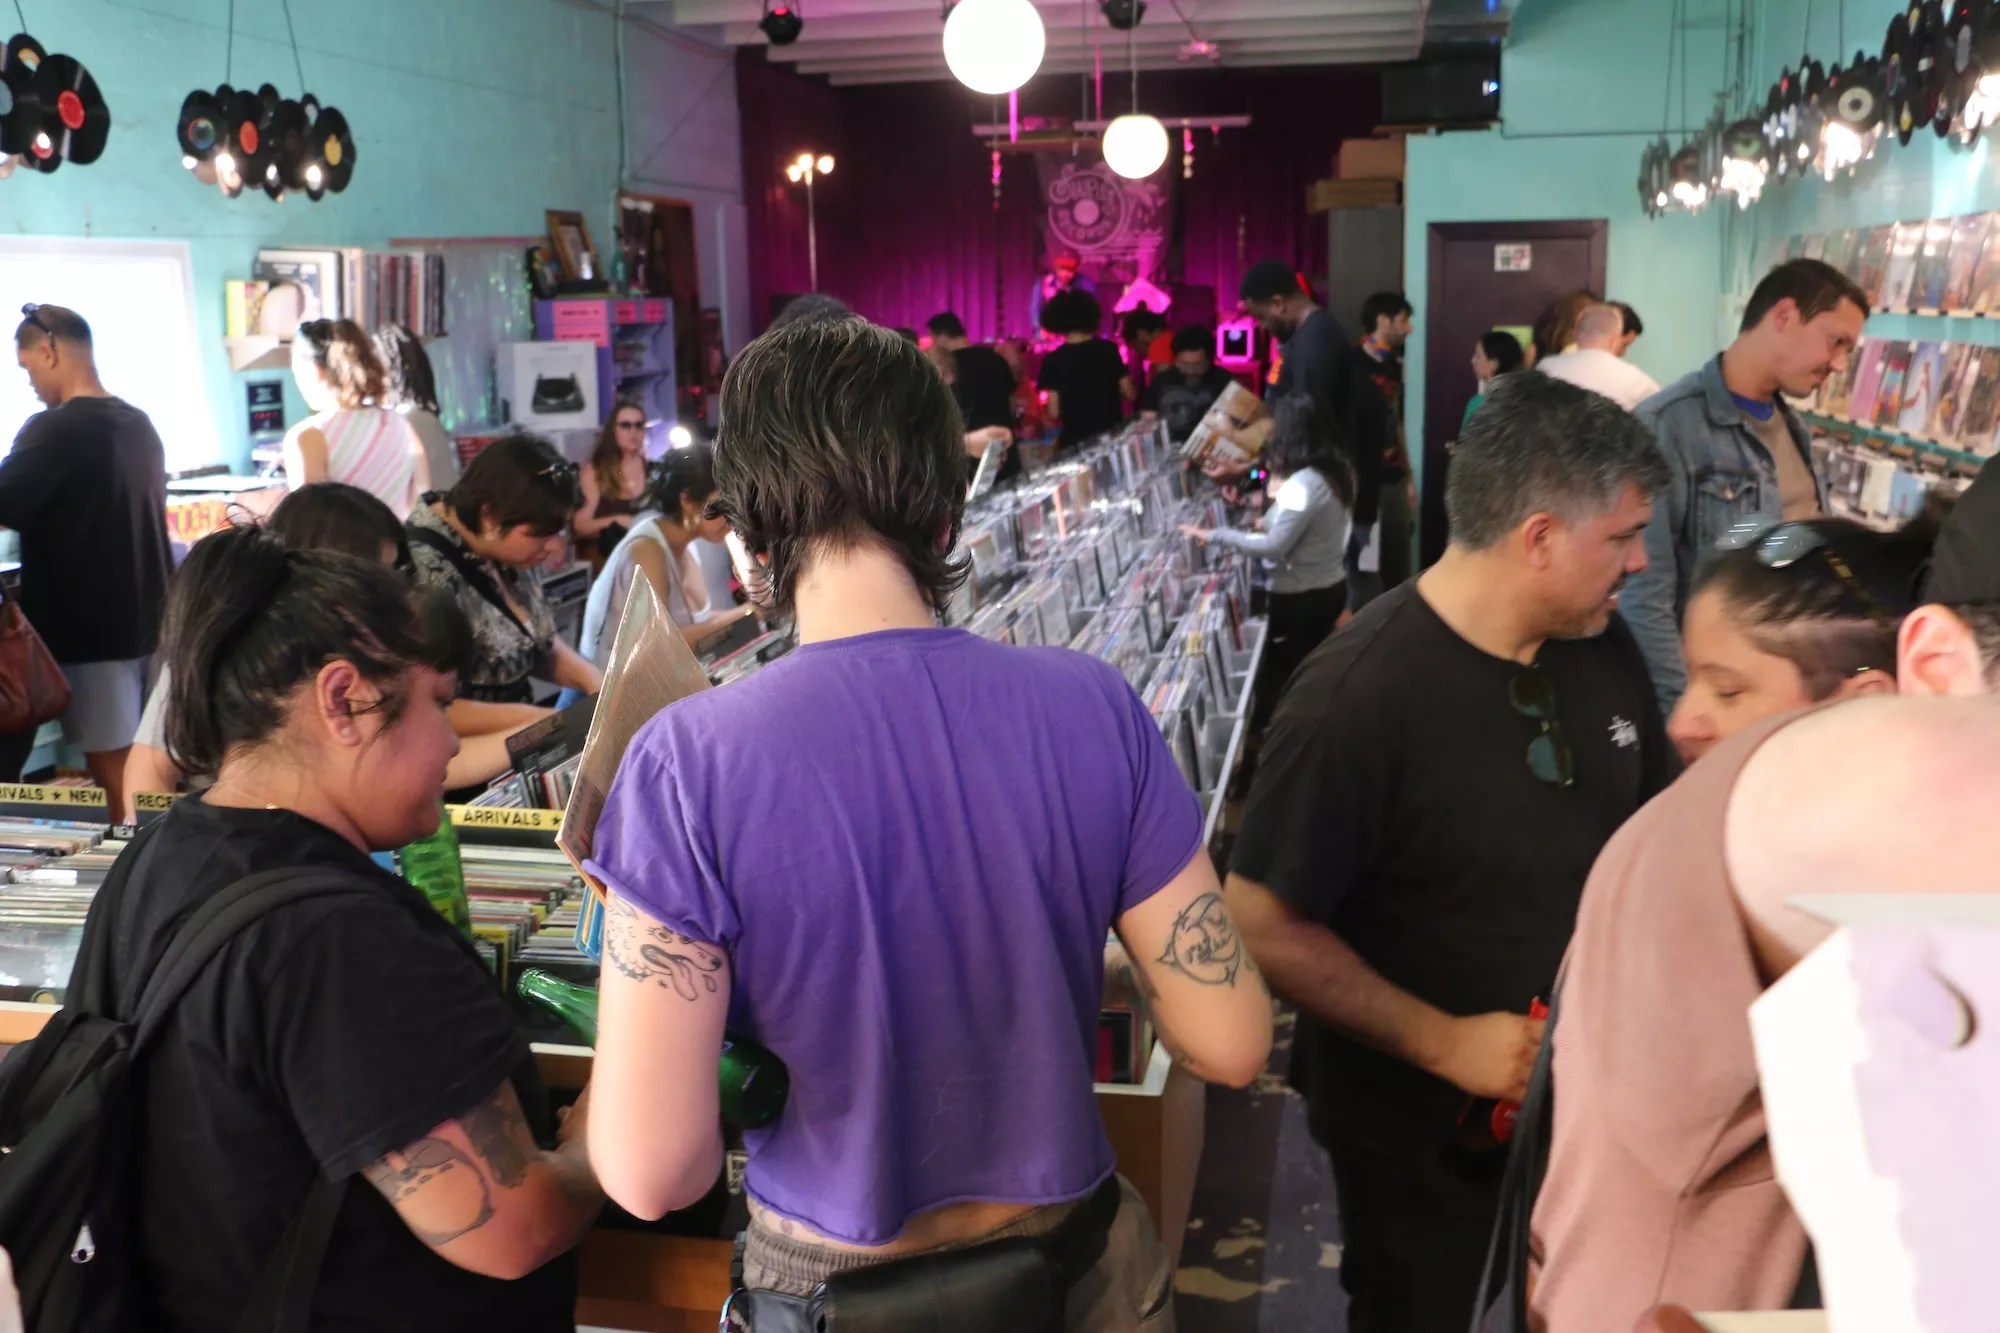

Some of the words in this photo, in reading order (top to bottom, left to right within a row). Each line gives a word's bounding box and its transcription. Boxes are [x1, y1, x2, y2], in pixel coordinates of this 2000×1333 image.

[0, 787, 43, 800] IVALS
[69, 788, 102, 803] NEW
[464, 809, 541, 826] ARRIVALS
